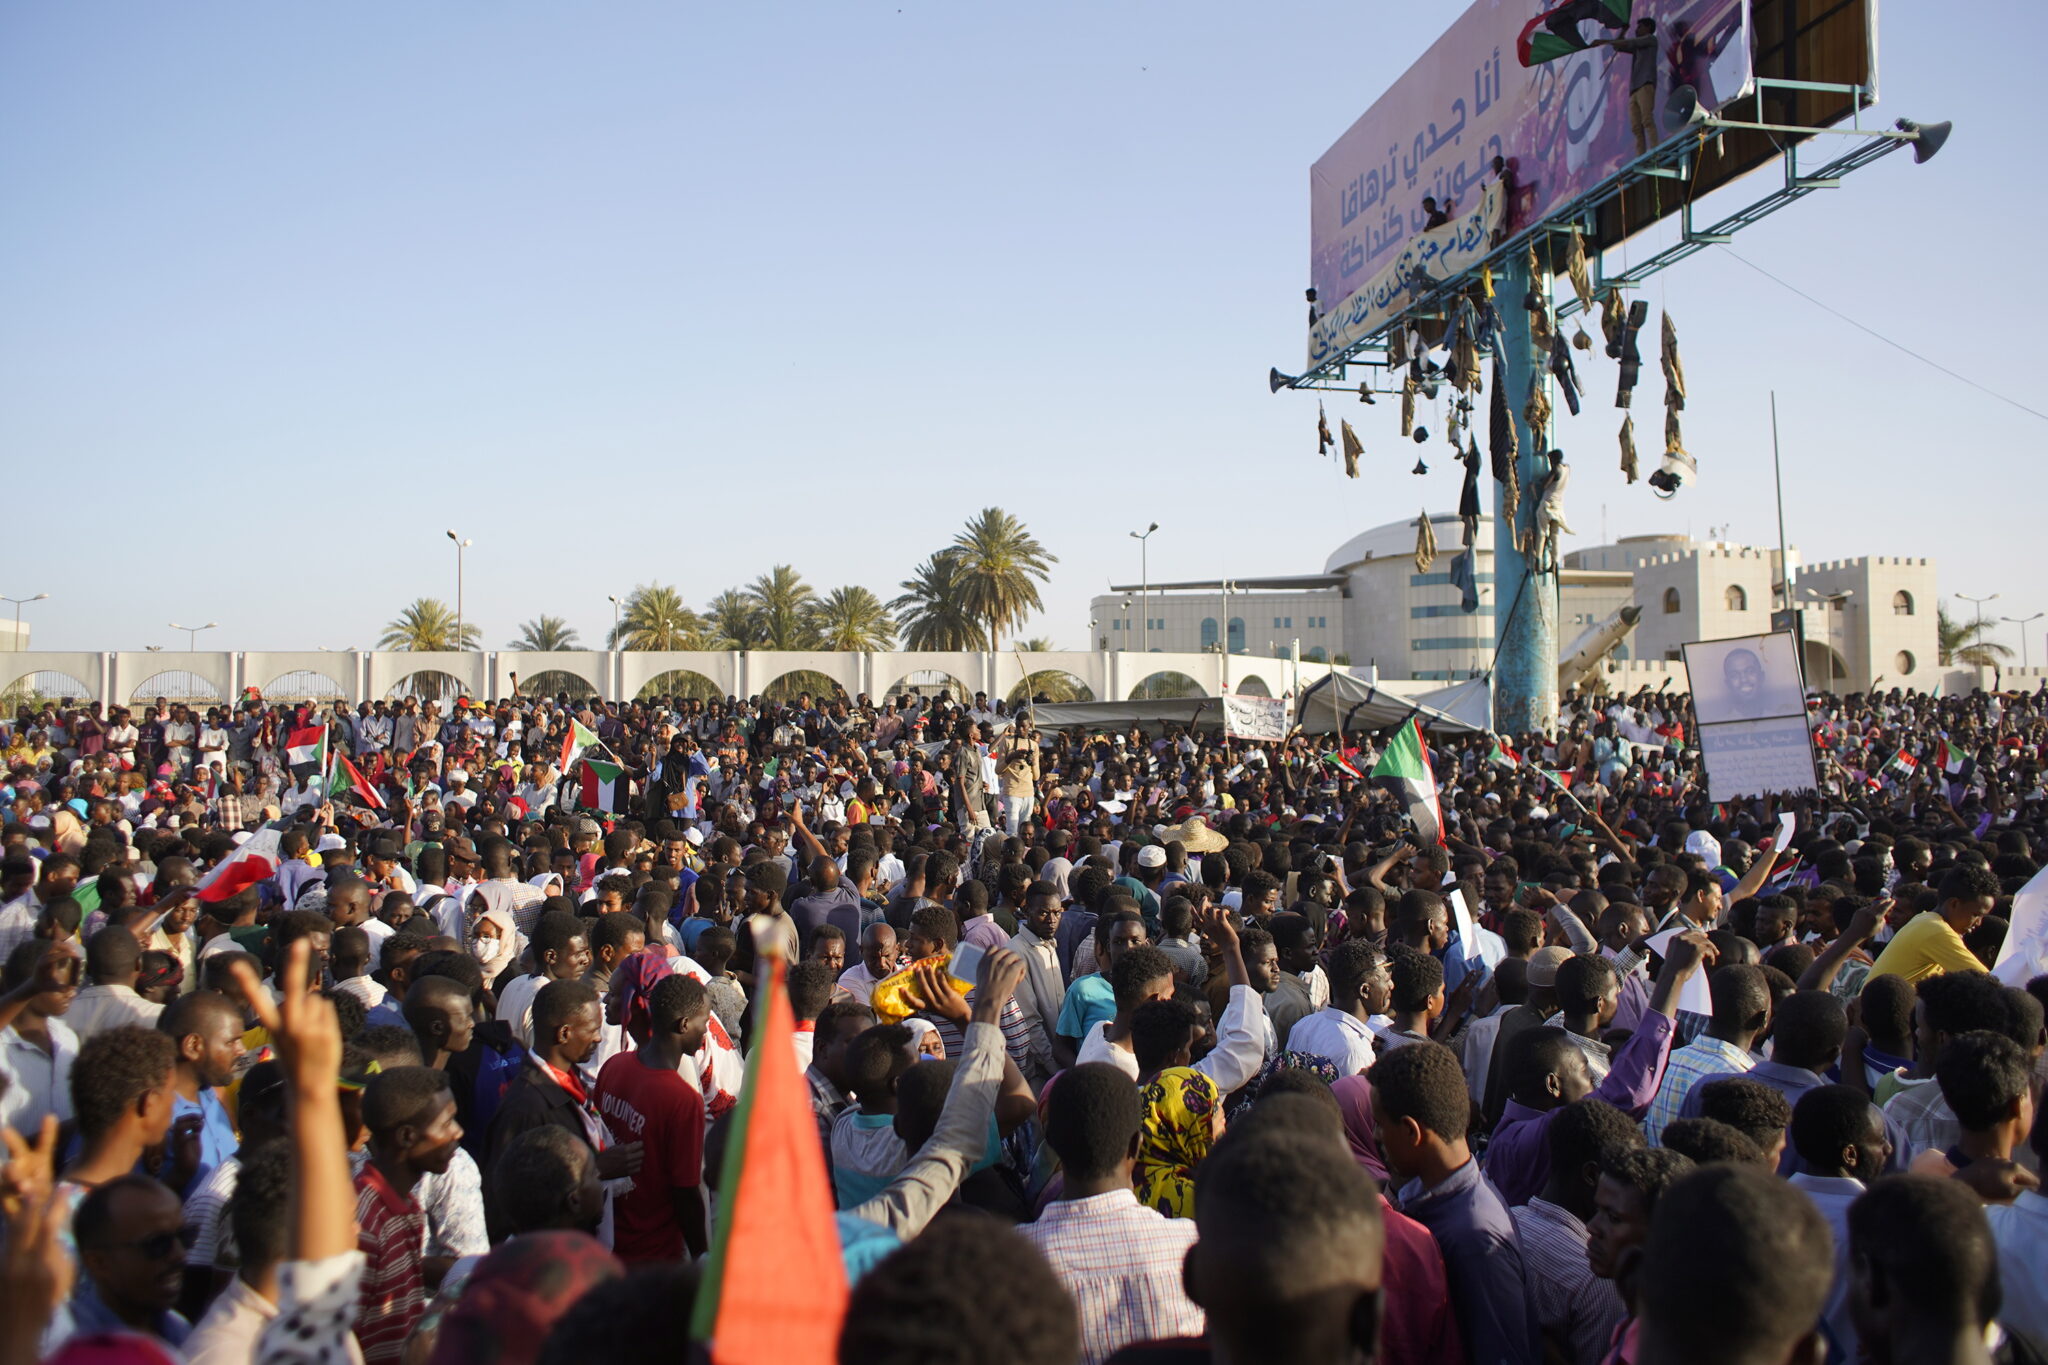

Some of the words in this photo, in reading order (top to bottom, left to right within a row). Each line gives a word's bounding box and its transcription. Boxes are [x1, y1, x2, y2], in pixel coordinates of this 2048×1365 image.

[1475, 46, 1501, 117] أنا
[1403, 98, 1467, 190] جدي
[1341, 143, 1399, 228] ترهاقا
[1341, 205, 1404, 279] كنداكة
